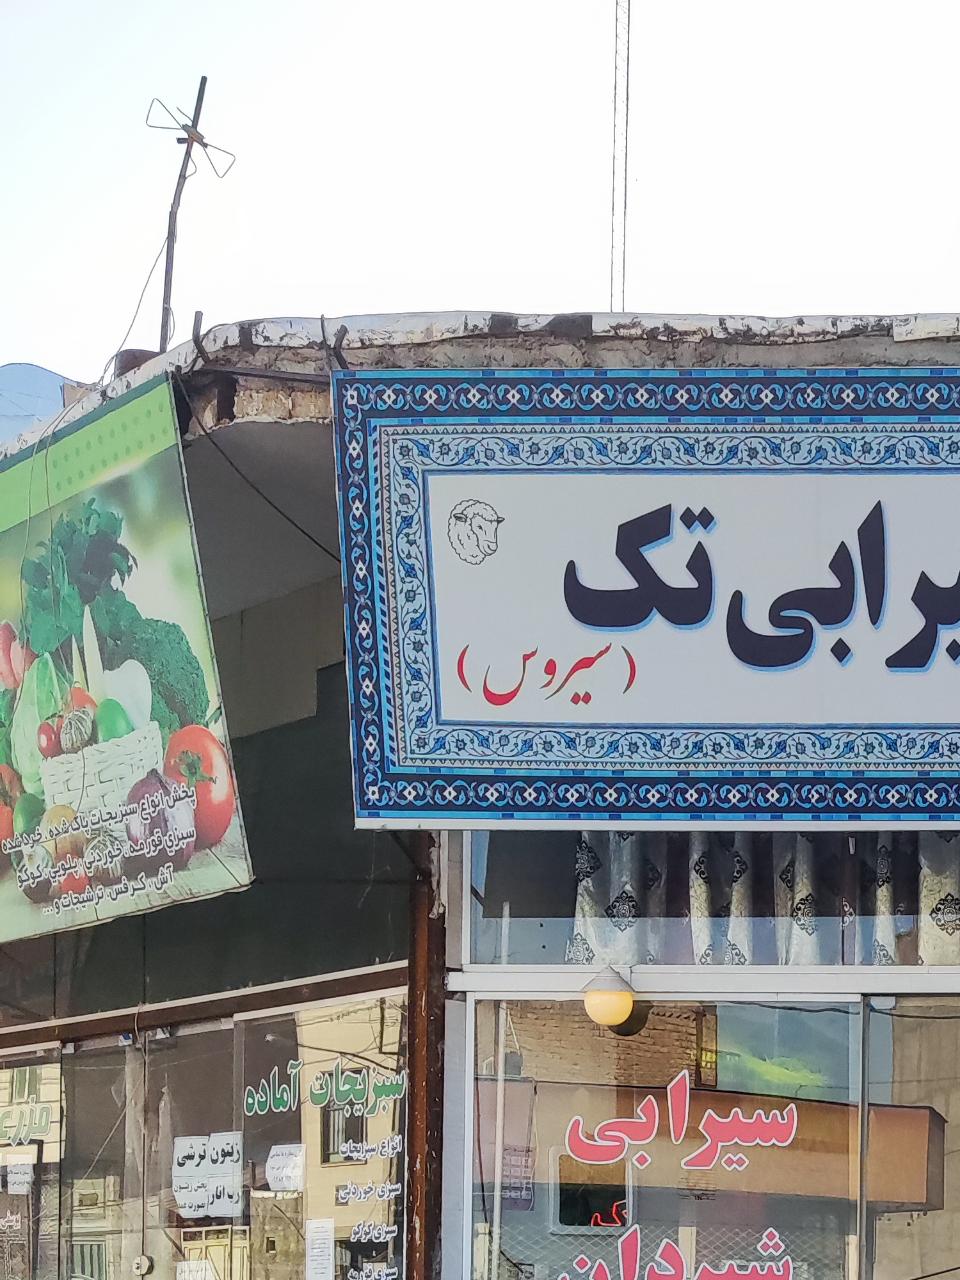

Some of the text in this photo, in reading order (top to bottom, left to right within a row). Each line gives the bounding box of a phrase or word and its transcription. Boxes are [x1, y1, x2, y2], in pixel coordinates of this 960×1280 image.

[563, 503, 717, 630] تک
[140, 791, 165, 822] انواع
[166, 785, 196, 809] پخش
[70, 812, 90, 837] پاک
[91, 803, 138, 827] سبزیجات
[244, 1058, 408, 1117] سبزیجات آماده
[564, 1069, 798, 1170] سیرابی
[177, 1143, 207, 1167] ترشی
[210, 1142, 241, 1164] زیتون
[339, 1135, 403, 1161] انواع سبزیجات
[209, 1185, 225, 1205] انار
[339, 1179, 402, 1203] سبزی خوردنی
[350, 1220, 399, 1243] سبزی کوکو
